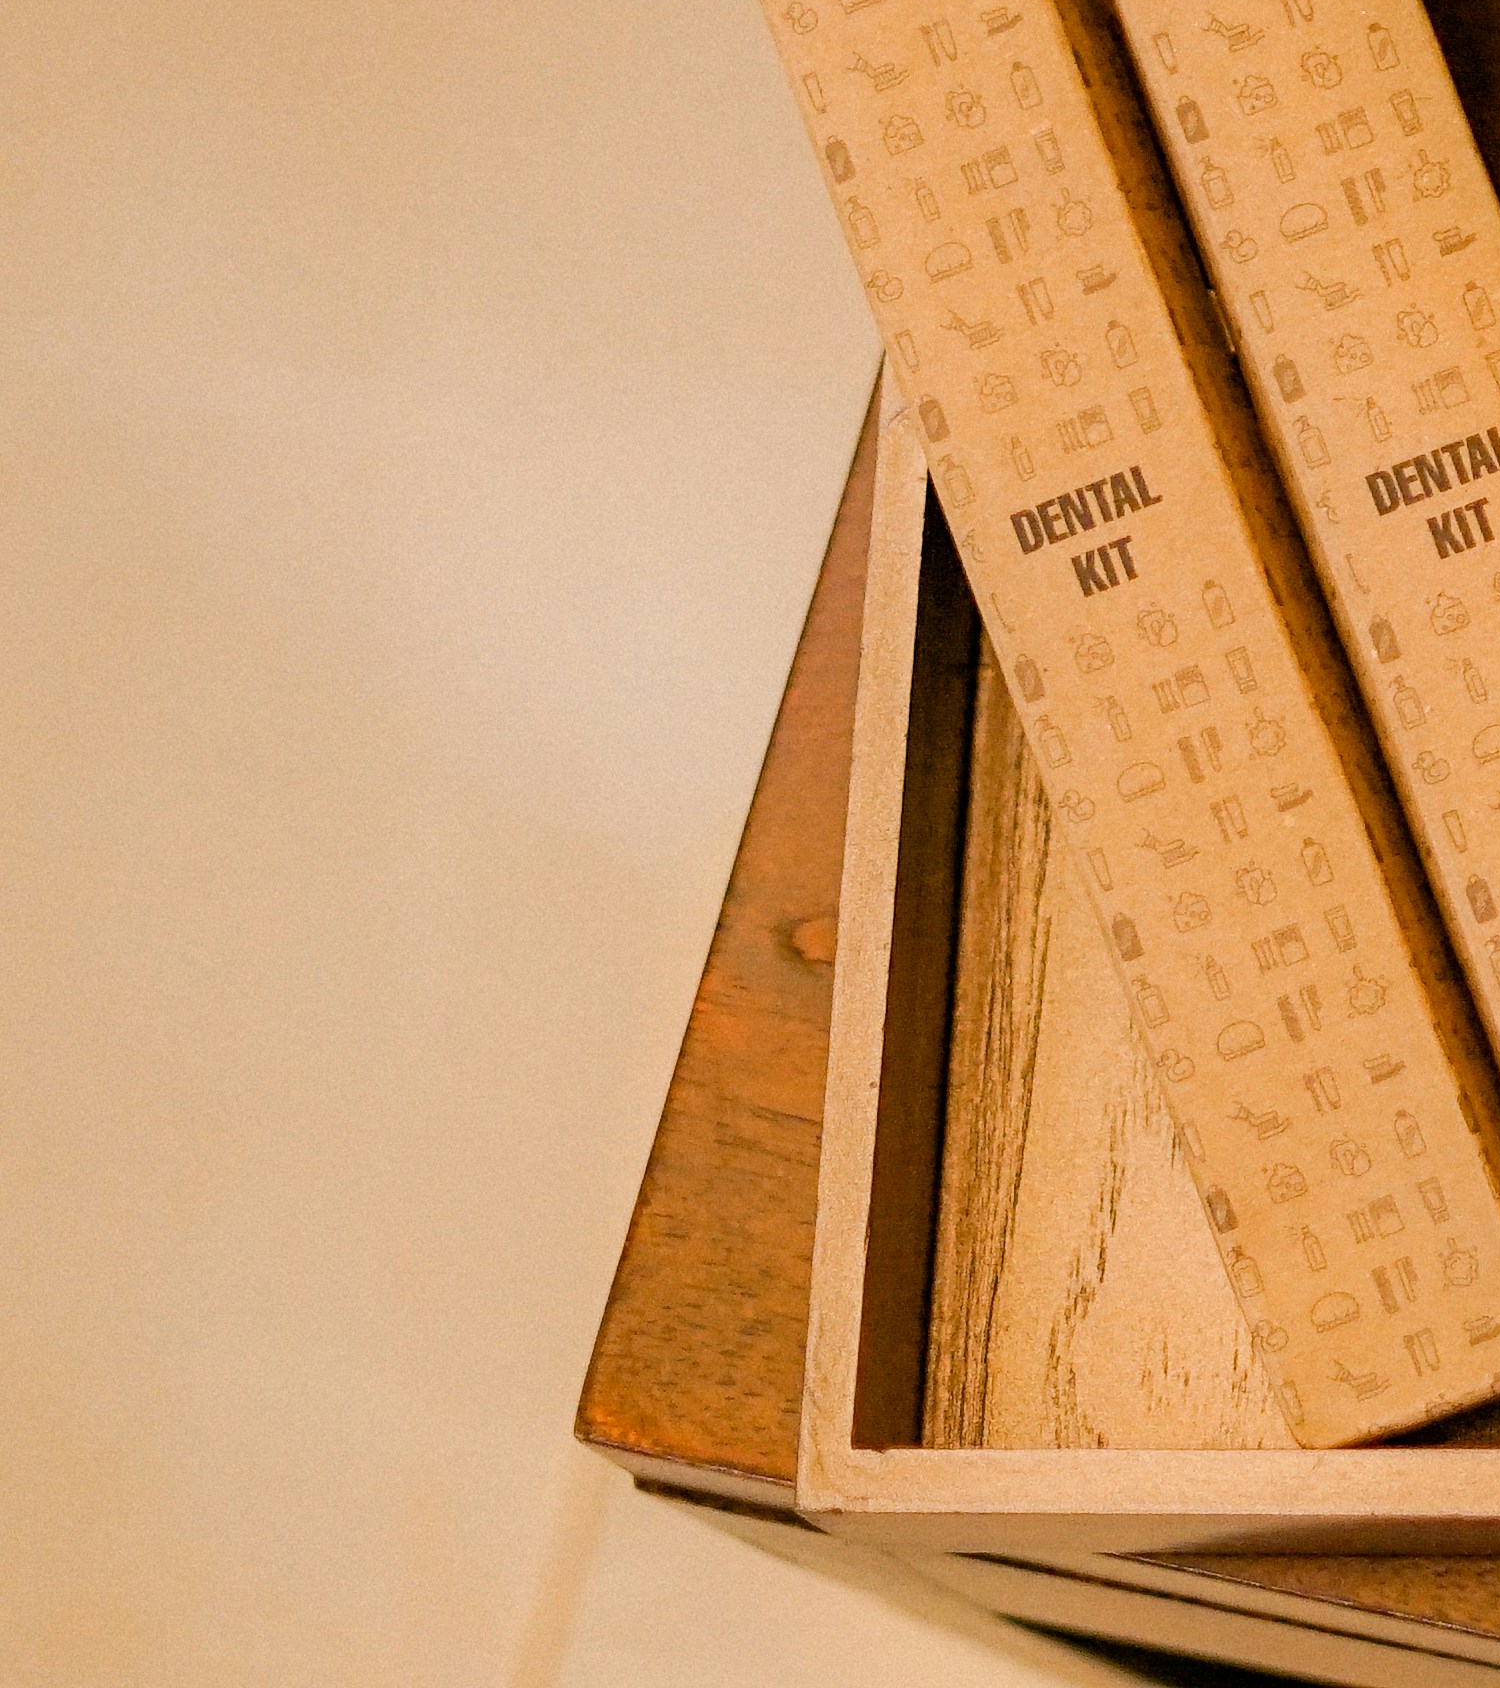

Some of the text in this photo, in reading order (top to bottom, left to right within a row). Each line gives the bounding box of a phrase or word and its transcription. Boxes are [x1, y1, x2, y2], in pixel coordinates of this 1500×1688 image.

[1009, 465, 1163, 556] DENTAL
[1427, 498, 1500, 560] KIT
[1071, 536, 1140, 598] KIT
